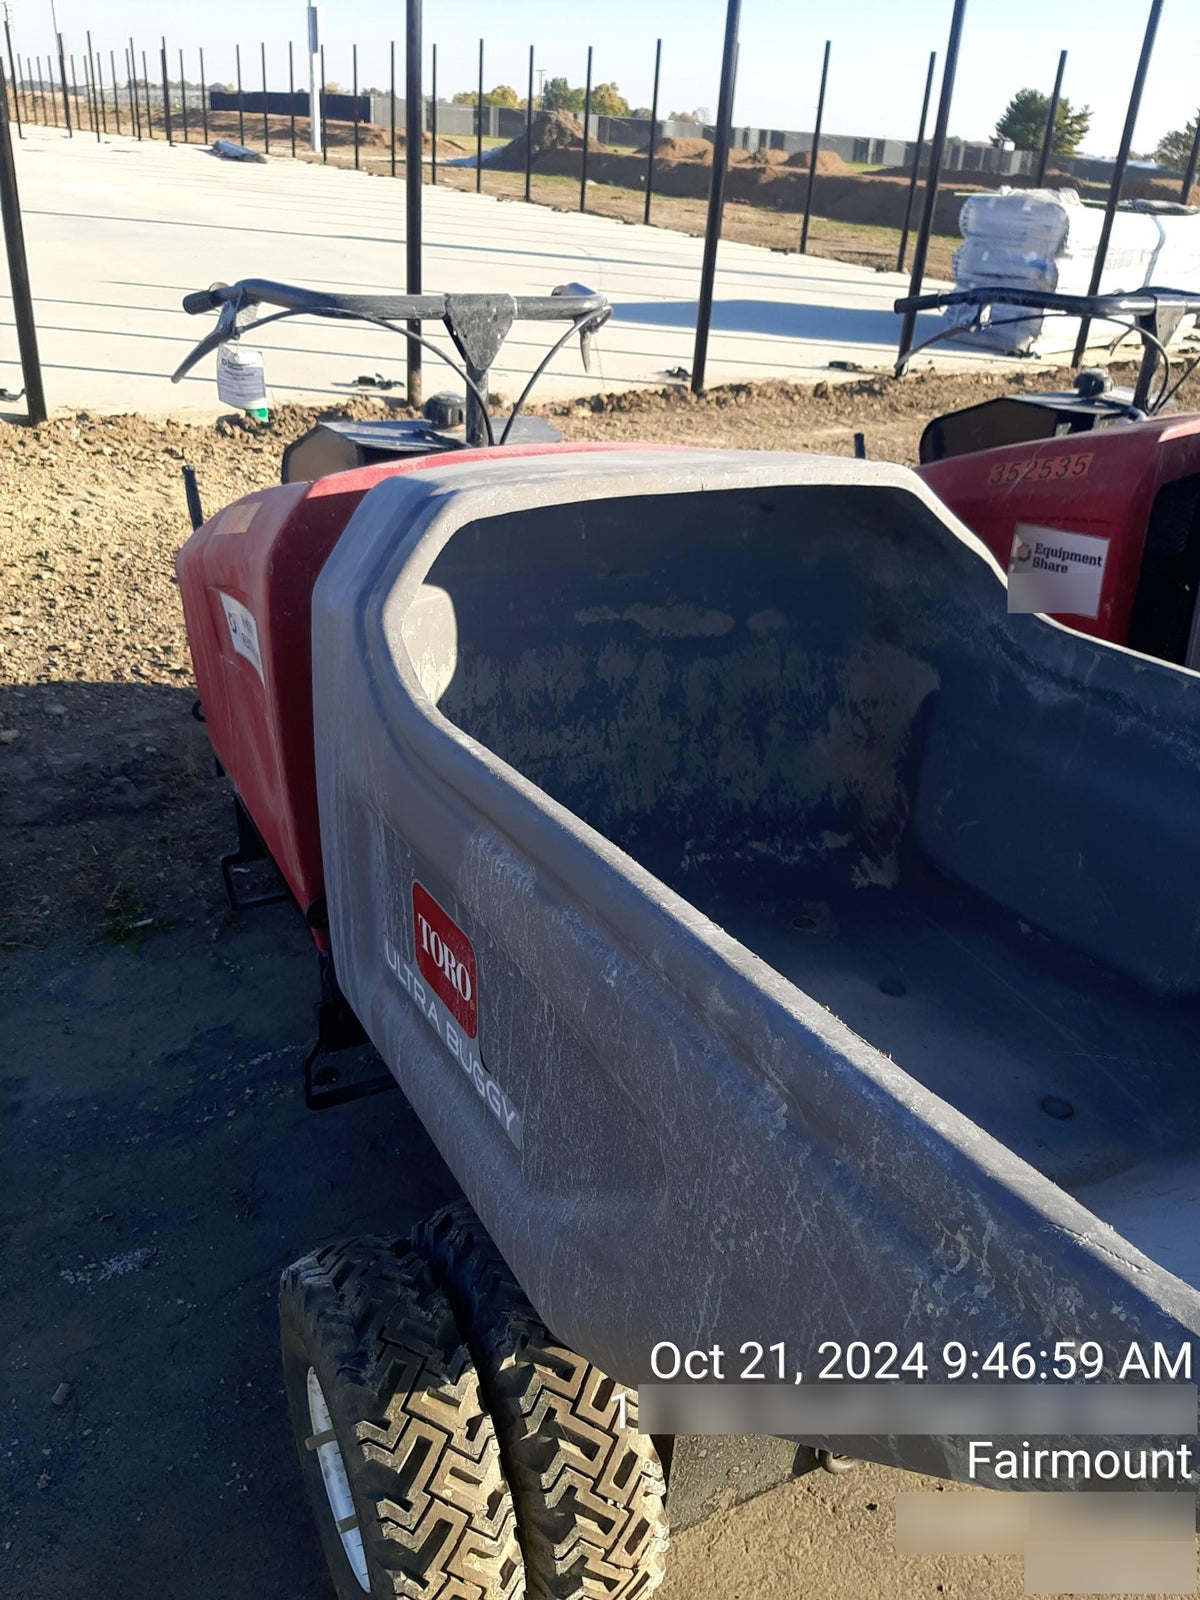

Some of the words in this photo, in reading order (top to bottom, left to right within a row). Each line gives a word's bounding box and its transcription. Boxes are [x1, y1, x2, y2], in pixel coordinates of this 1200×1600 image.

[990, 456, 1087, 484] 352535
[1032, 557, 1069, 574] Share
[1034, 542, 1102, 567] Equipment
[418, 912, 472, 1003] TORO
[385, 943, 441, 1032] ULTRA
[446, 1020, 516, 1132] BUGGY
